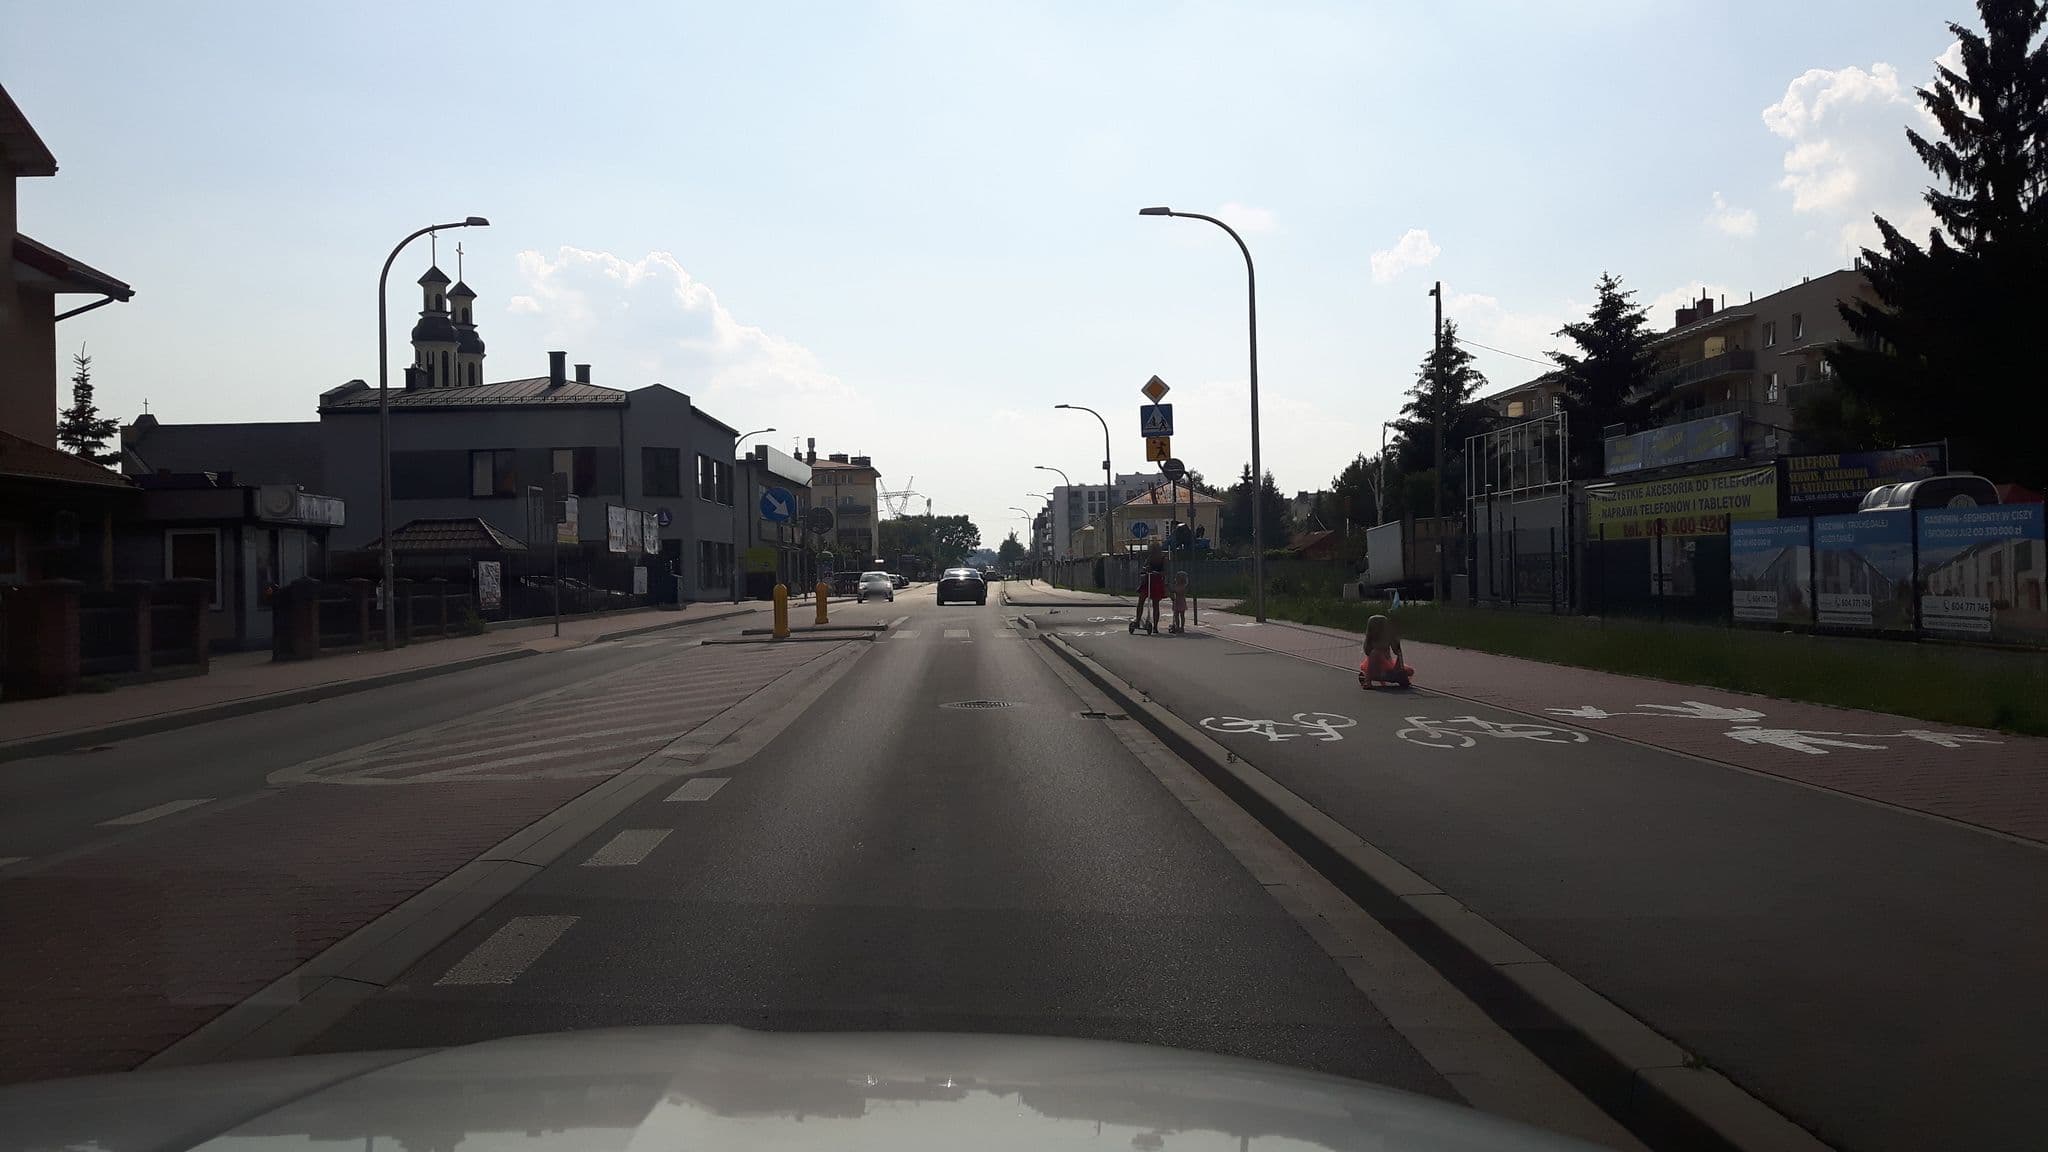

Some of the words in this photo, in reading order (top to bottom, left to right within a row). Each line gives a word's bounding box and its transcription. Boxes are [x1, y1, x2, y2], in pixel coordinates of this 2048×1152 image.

[1788, 454, 1840, 470] TELEFONY
[1646, 482, 1693, 496] AKCESORIA
[1696, 479, 1709, 491] DO
[1602, 506, 1638, 518] NAPRAWA
[1963, 511, 2001, 522] SEGMENTY
[2003, 511, 2010, 520] W
[2011, 510, 2033, 520] CISZY
[1973, 527, 1984, 536] OD
